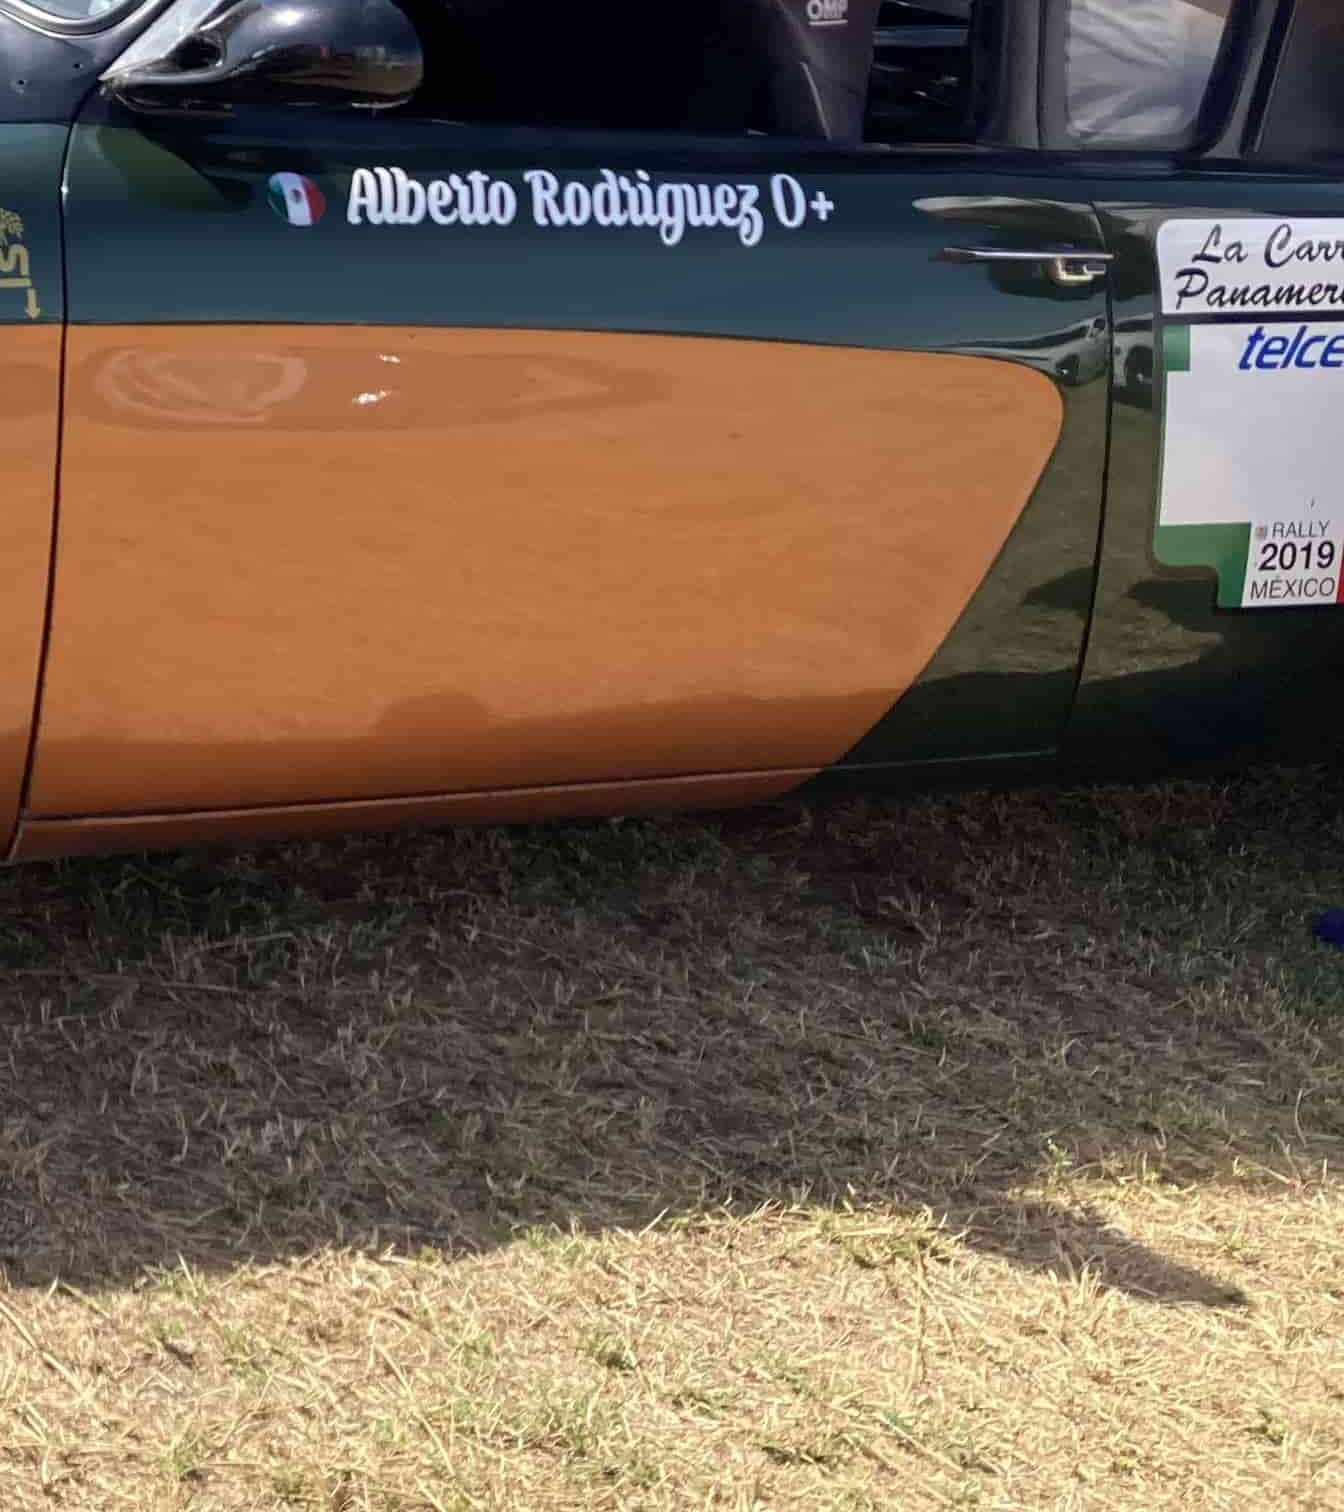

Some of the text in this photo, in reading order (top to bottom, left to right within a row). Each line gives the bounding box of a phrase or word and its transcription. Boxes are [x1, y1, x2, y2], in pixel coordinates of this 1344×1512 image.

[346, 167, 517, 226] Alberto
[523, 168, 764, 247] Rodriguez
[1191, 223, 1248, 264] La
[1238, 325, 1344, 370] telce
[1272, 520, 1330, 537] RALLY
[1258, 540, 1335, 571] 2019
